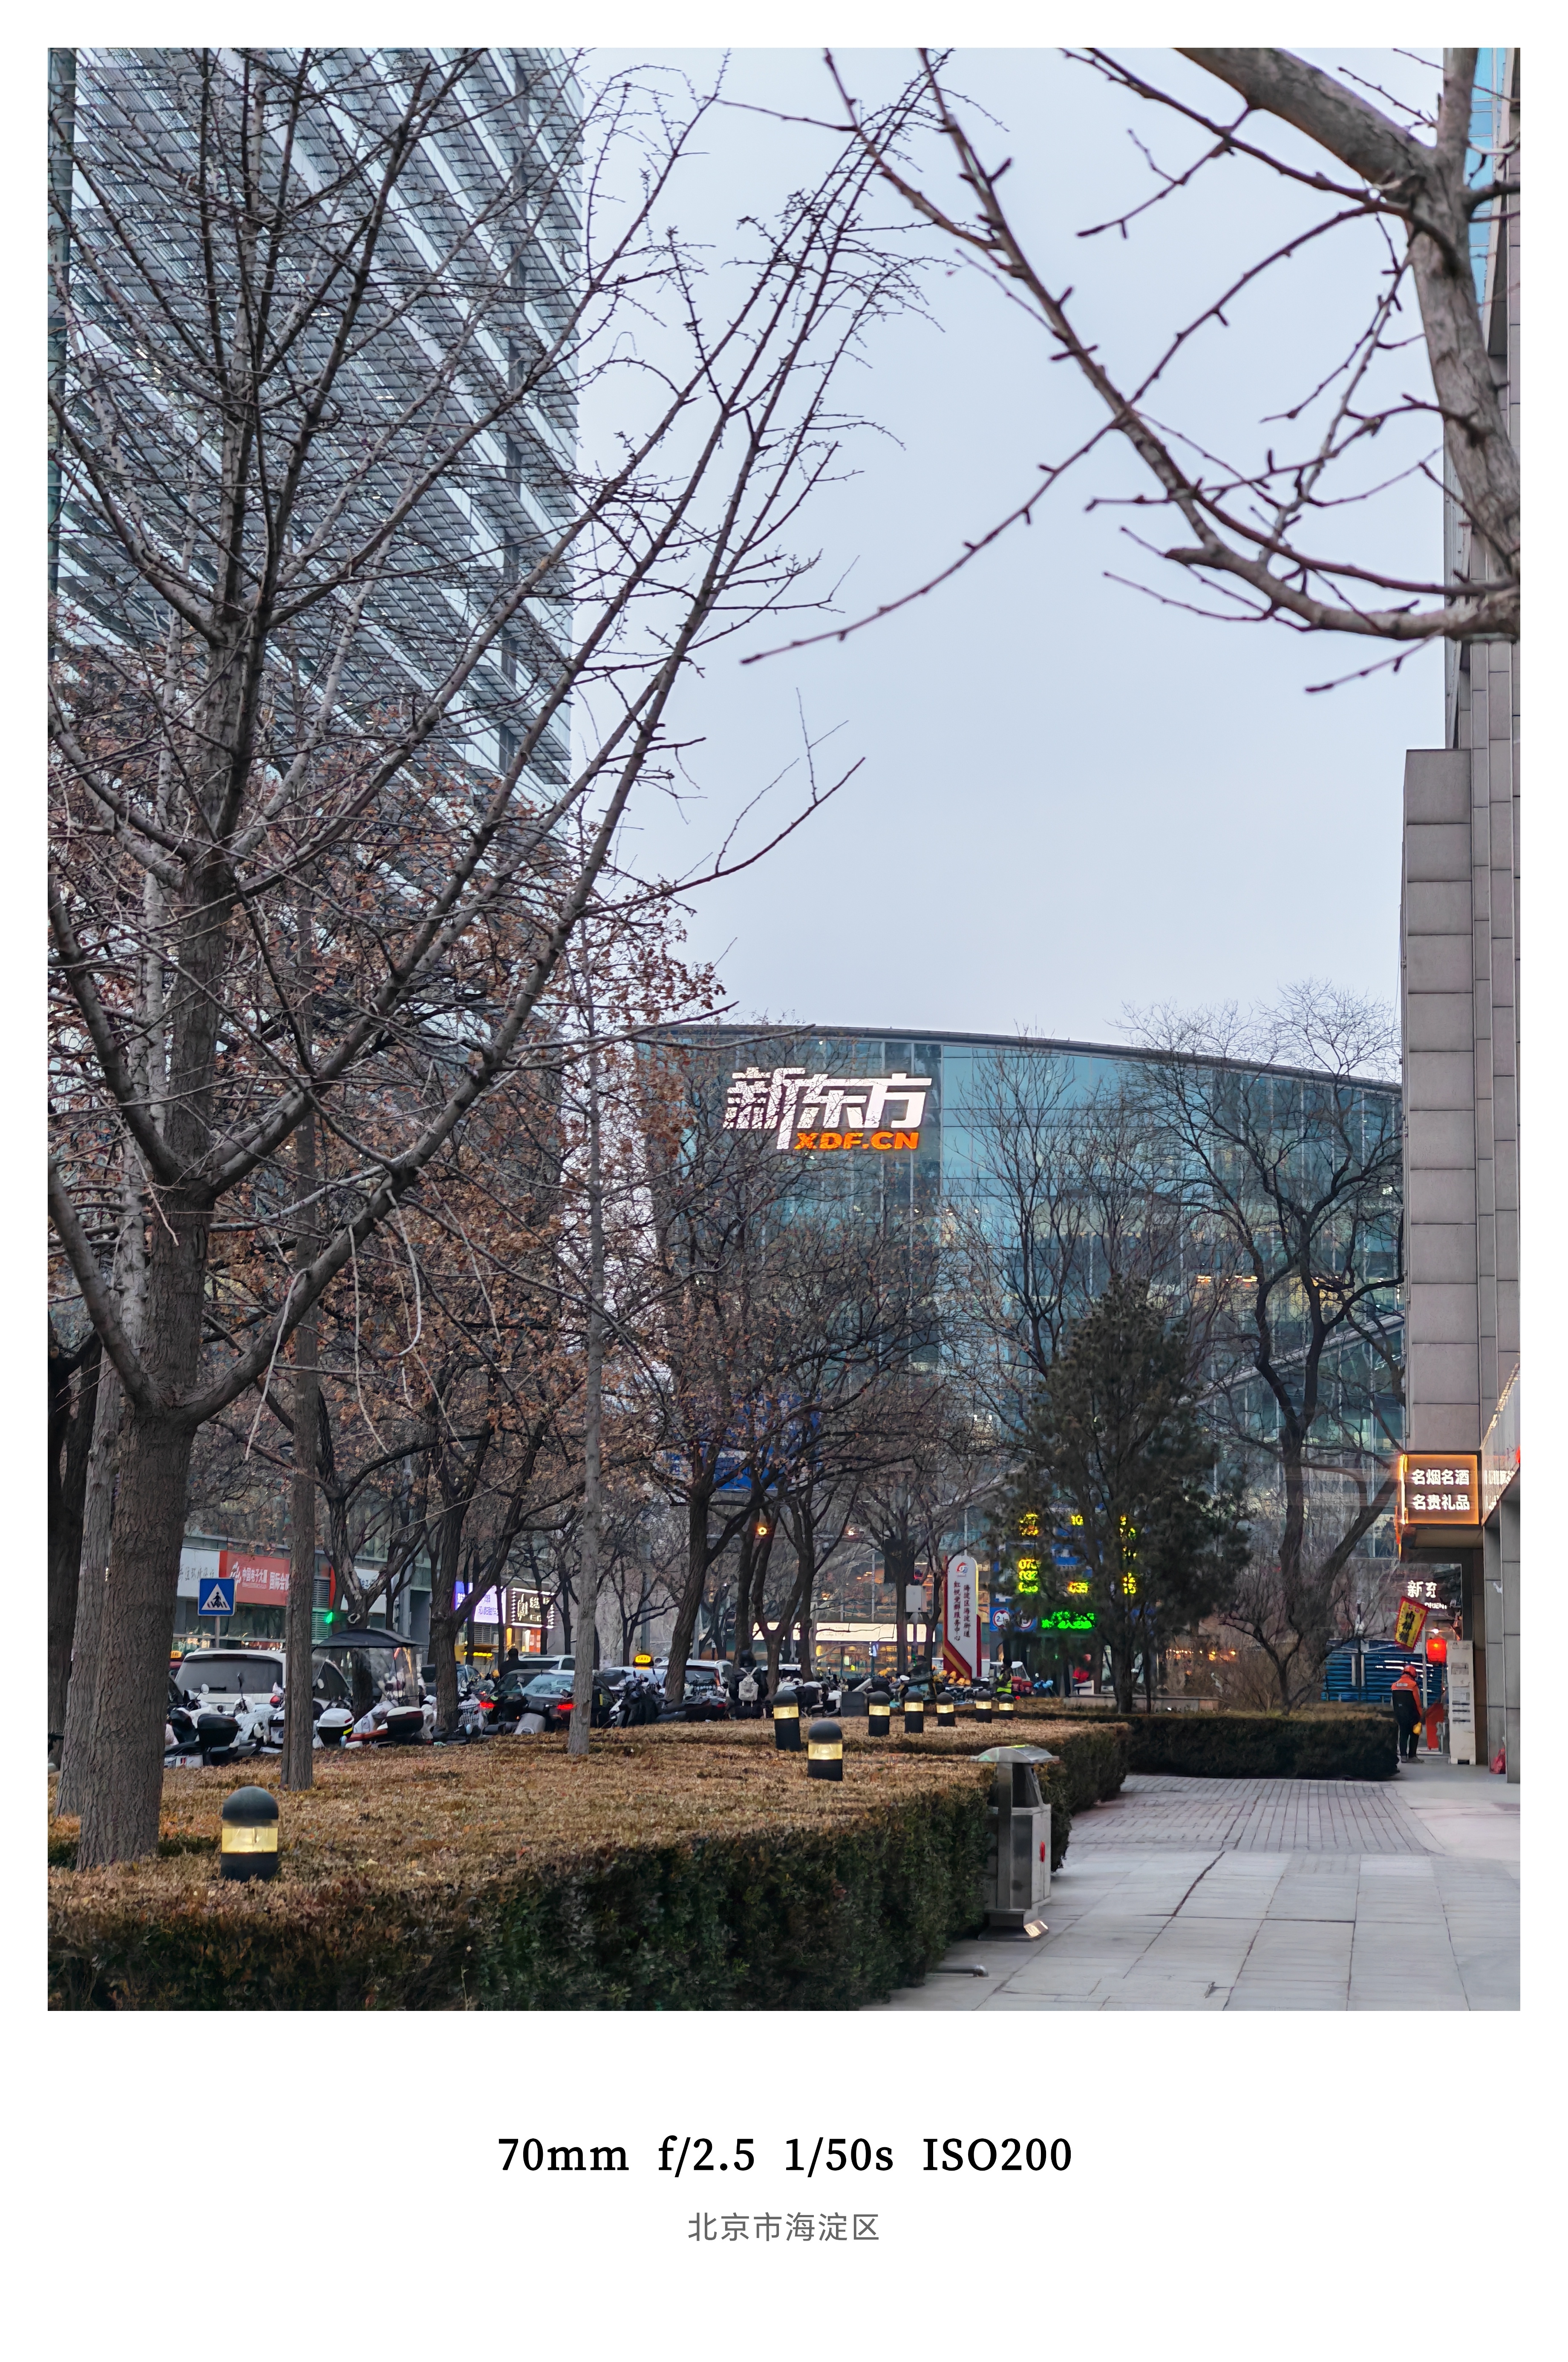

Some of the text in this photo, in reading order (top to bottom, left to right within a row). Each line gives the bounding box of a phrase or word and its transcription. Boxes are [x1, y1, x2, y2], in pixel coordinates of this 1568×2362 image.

[723, 1067, 932, 1149] 新东方
[794, 1132, 919, 1149] XDF.CN
[1412, 1469, 1470, 1485] 名烟名酒
[1412, 1494, 1470, 1510] 名贵礼品
